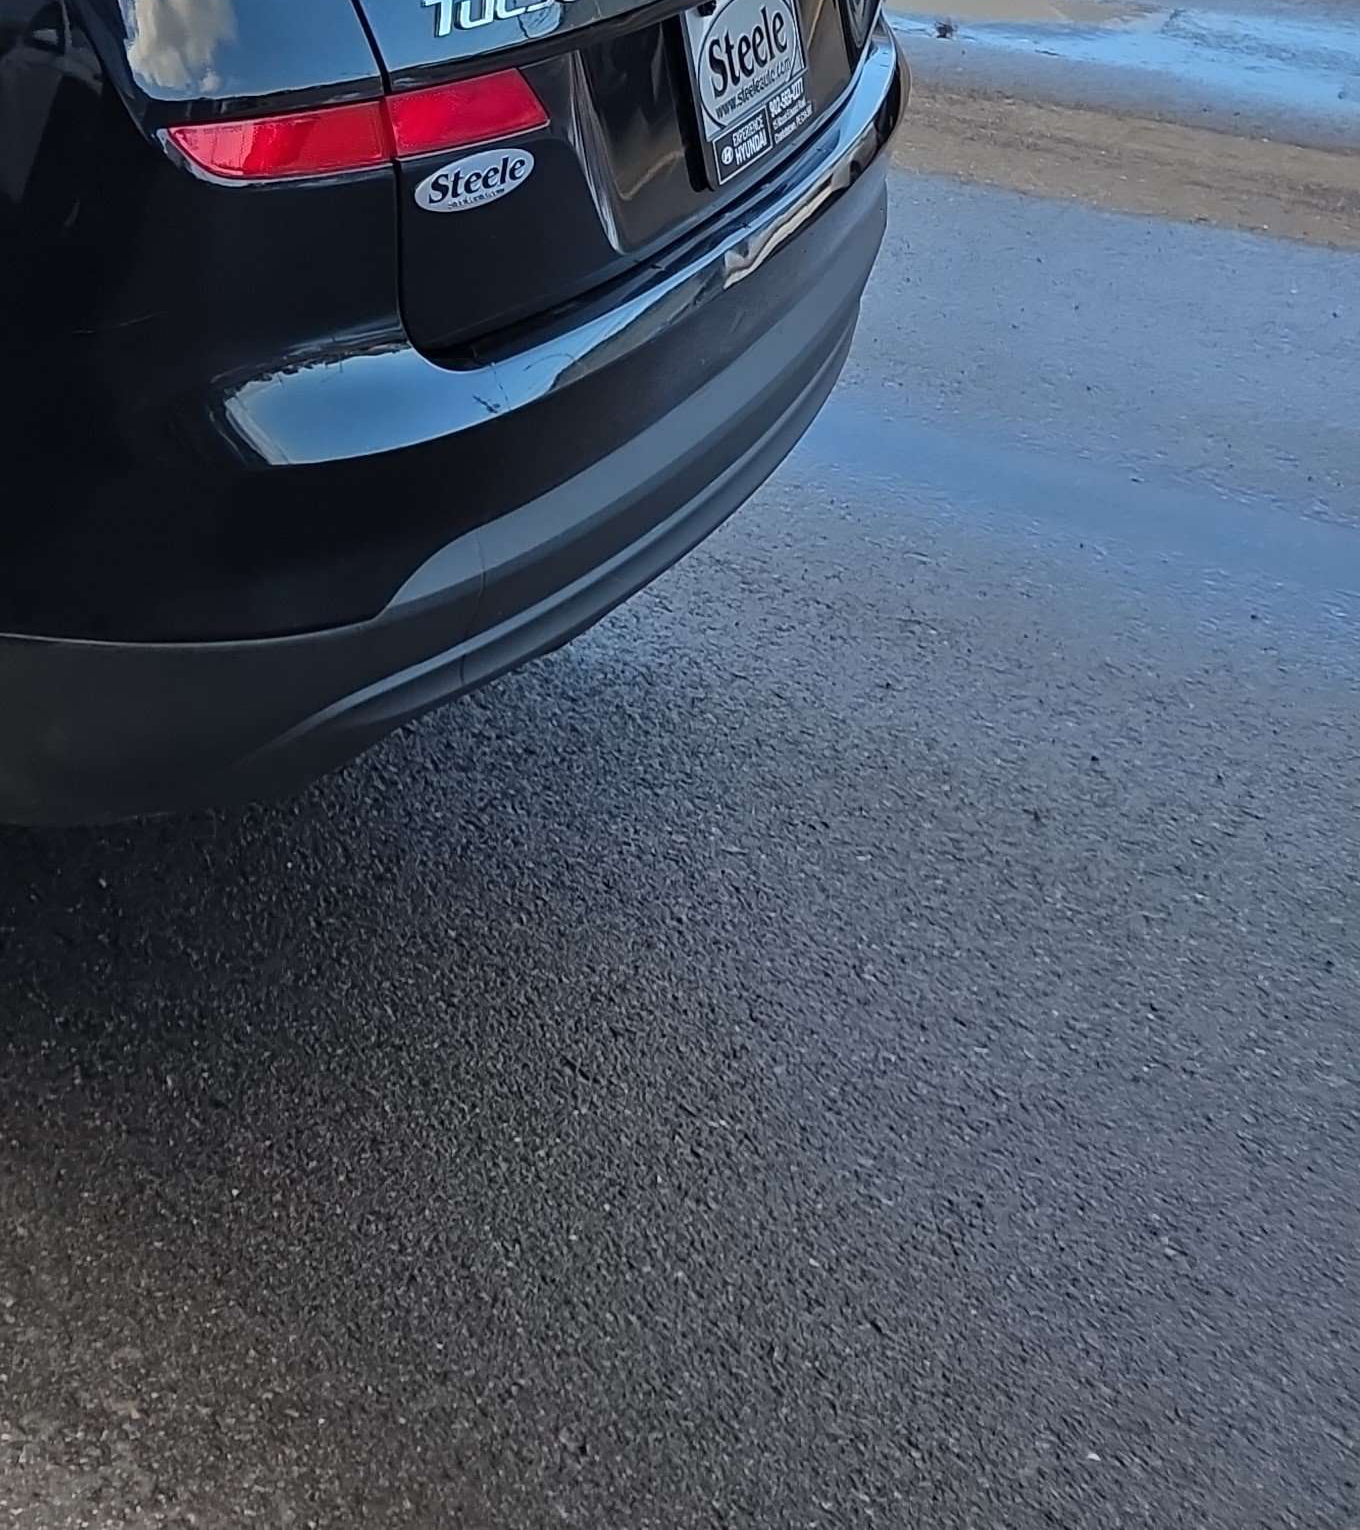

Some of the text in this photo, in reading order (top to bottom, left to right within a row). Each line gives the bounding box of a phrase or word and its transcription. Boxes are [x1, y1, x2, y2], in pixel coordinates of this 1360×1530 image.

[708, 6, 788, 98] Steele
[734, 128, 768, 166] HYUNDAI
[428, 156, 526, 204] Steele
